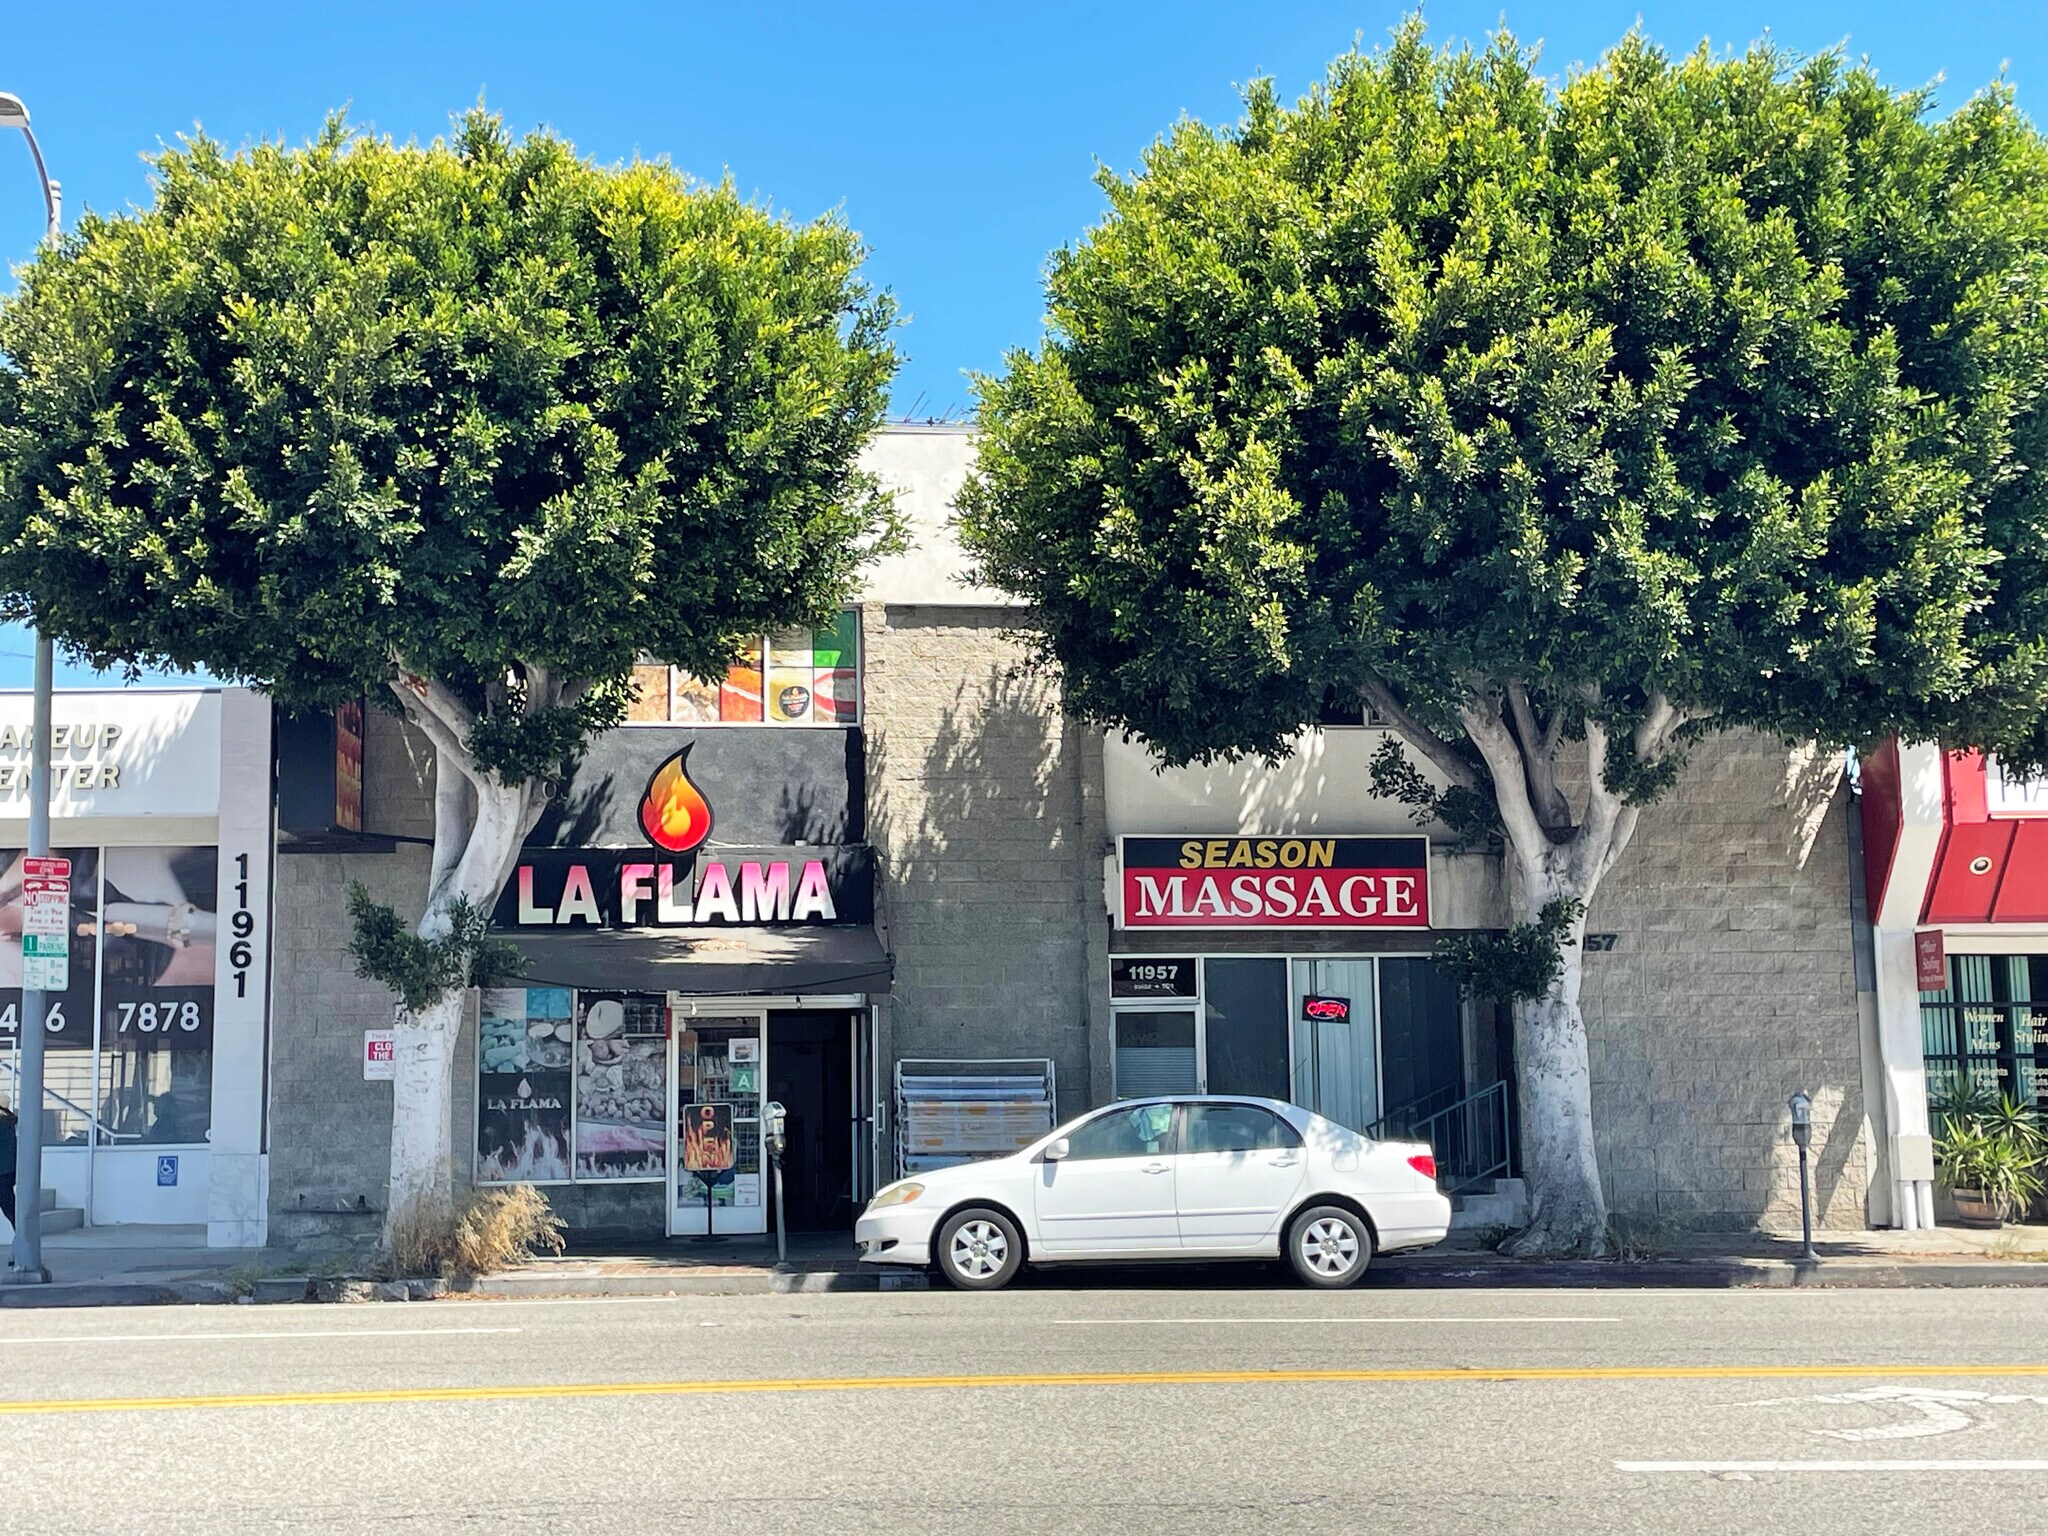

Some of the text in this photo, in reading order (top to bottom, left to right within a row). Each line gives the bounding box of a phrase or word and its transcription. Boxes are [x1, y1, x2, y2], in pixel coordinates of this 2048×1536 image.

[1179, 840, 1336, 869] SEASON
[24, 891, 38, 905] NO
[518, 861, 837, 924] LA FLAMA
[1134, 875, 1418, 918] MASSAGE
[230, 853, 254, 998] 11961
[1583, 934, 1617, 951] 57
[1129, 965, 1178, 980] 11957
[0, 1002, 200, 1032] 46 7878
[1306, 1001, 1347, 1018] OPEN
[1963, 1010, 2004, 1023] Women
[2021, 1013, 2048, 1027] Hair
[1979, 1025, 1989, 1036] &
[2014, 1029, 2048, 1047] Stylin
[374, 1042, 394, 1051] CLO
[1971, 1039, 2001, 1050] Mens
[373, 1052, 390, 1060] THE
[738, 1074, 751, 1088] A
[487, 1098, 562, 1110] LA FLAMA
[701, 1106, 717, 1169] OPEN
